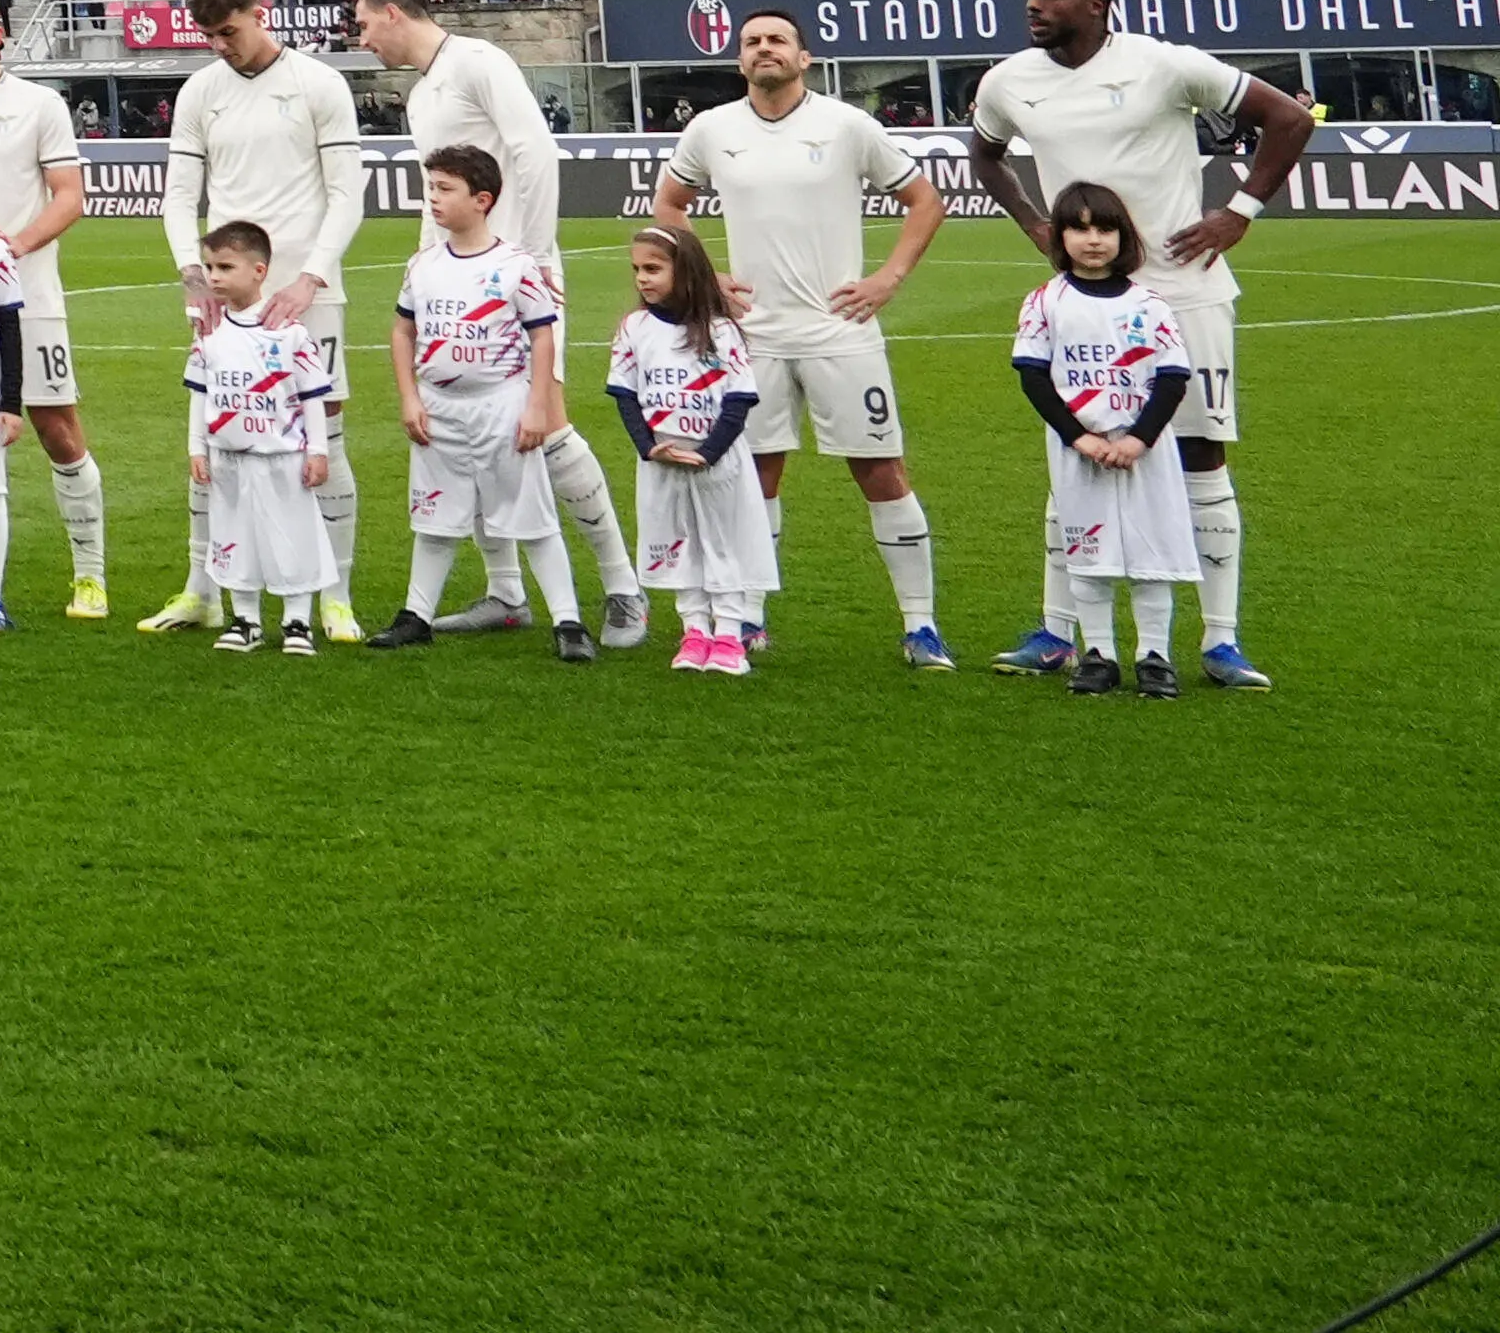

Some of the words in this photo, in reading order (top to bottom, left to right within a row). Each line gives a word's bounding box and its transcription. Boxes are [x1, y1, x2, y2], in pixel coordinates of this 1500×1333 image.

[83, 165, 163, 193] LUMI
[426, 298, 467, 315] KEEP
[424, 321, 488, 340] RACISM
[37, 344, 68, 380] 18
[320, 336, 337, 375] 7
[451, 345, 488, 363] OUT
[1064, 343, 1116, 363] KEEP
[644, 368, 689, 386] KEEP
[1067, 369, 1132, 388] RACIS
[1197, 367, 1230, 410] 17
[863, 385, 890, 425] 9
[1109, 393, 1145, 411] OUT
[243, 416, 276, 433] OUT
[678, 415, 713, 434] OUT
[1064, 525, 1086, 535] KEEP
[1067, 535, 1099, 545] RACISM
[1082, 545, 1100, 555] OUT
